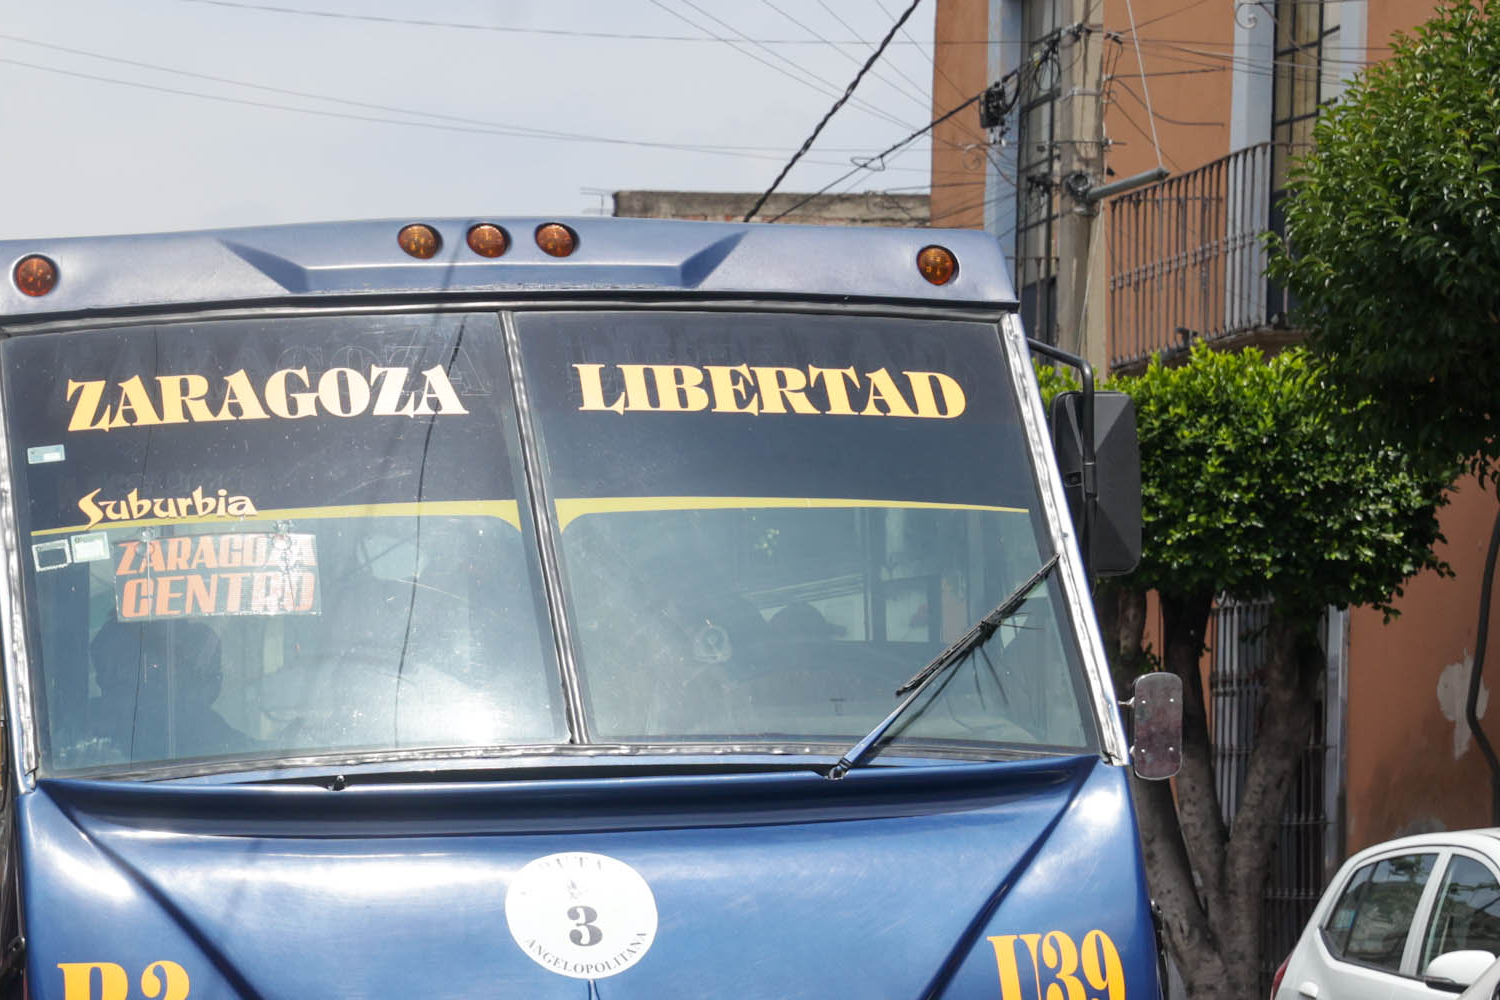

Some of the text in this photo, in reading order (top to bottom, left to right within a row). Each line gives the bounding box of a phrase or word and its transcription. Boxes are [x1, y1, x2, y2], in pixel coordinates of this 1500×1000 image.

[66, 364, 469, 432] ZARAGOZA
[572, 363, 967, 419] LIBERTAD
[78, 487, 258, 530] Suburbia
[121, 571, 316, 618] CENTRO
[566, 905, 604, 947] 3
[526, 933, 647, 974] ANGELOPOLITANA
